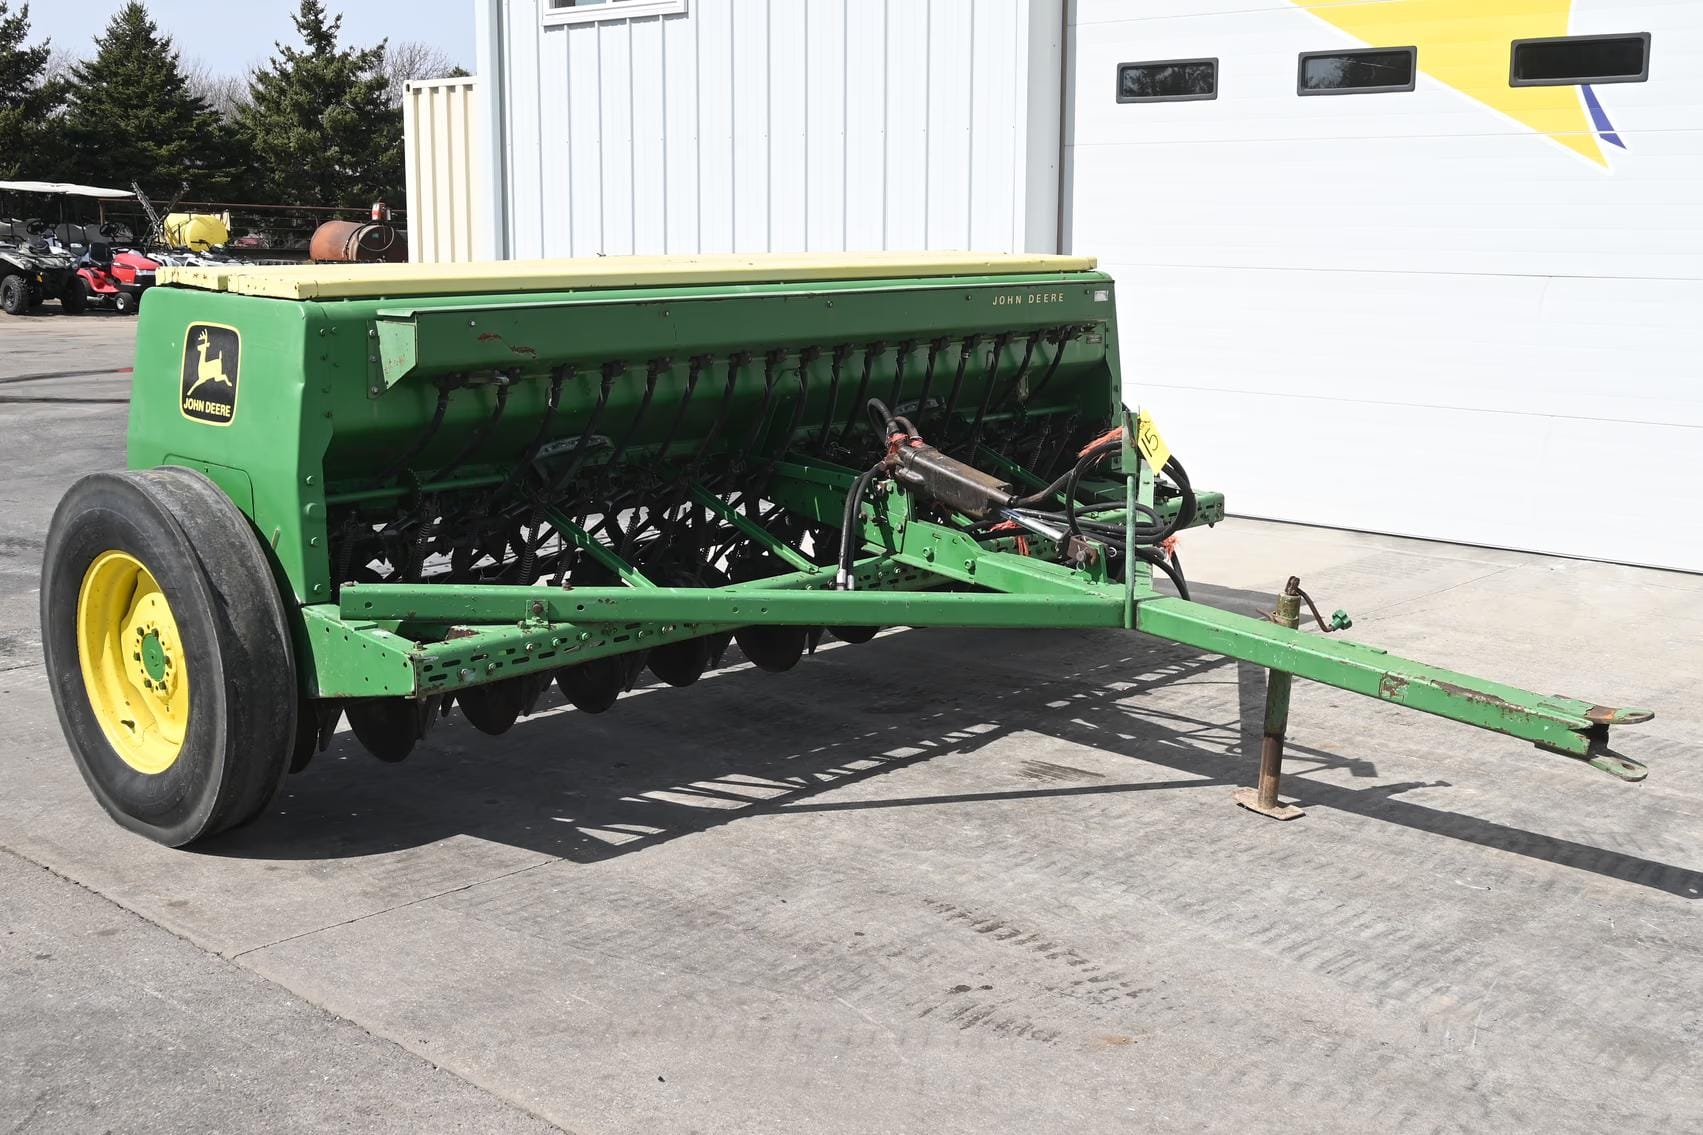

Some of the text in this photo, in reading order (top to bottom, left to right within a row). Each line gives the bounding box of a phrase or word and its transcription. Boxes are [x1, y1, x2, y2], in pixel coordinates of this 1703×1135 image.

[993, 293, 1064, 305] JOHN DEERE
[184, 398, 231, 417] JOHN DEERE
[1141, 427, 1159, 458] 15
